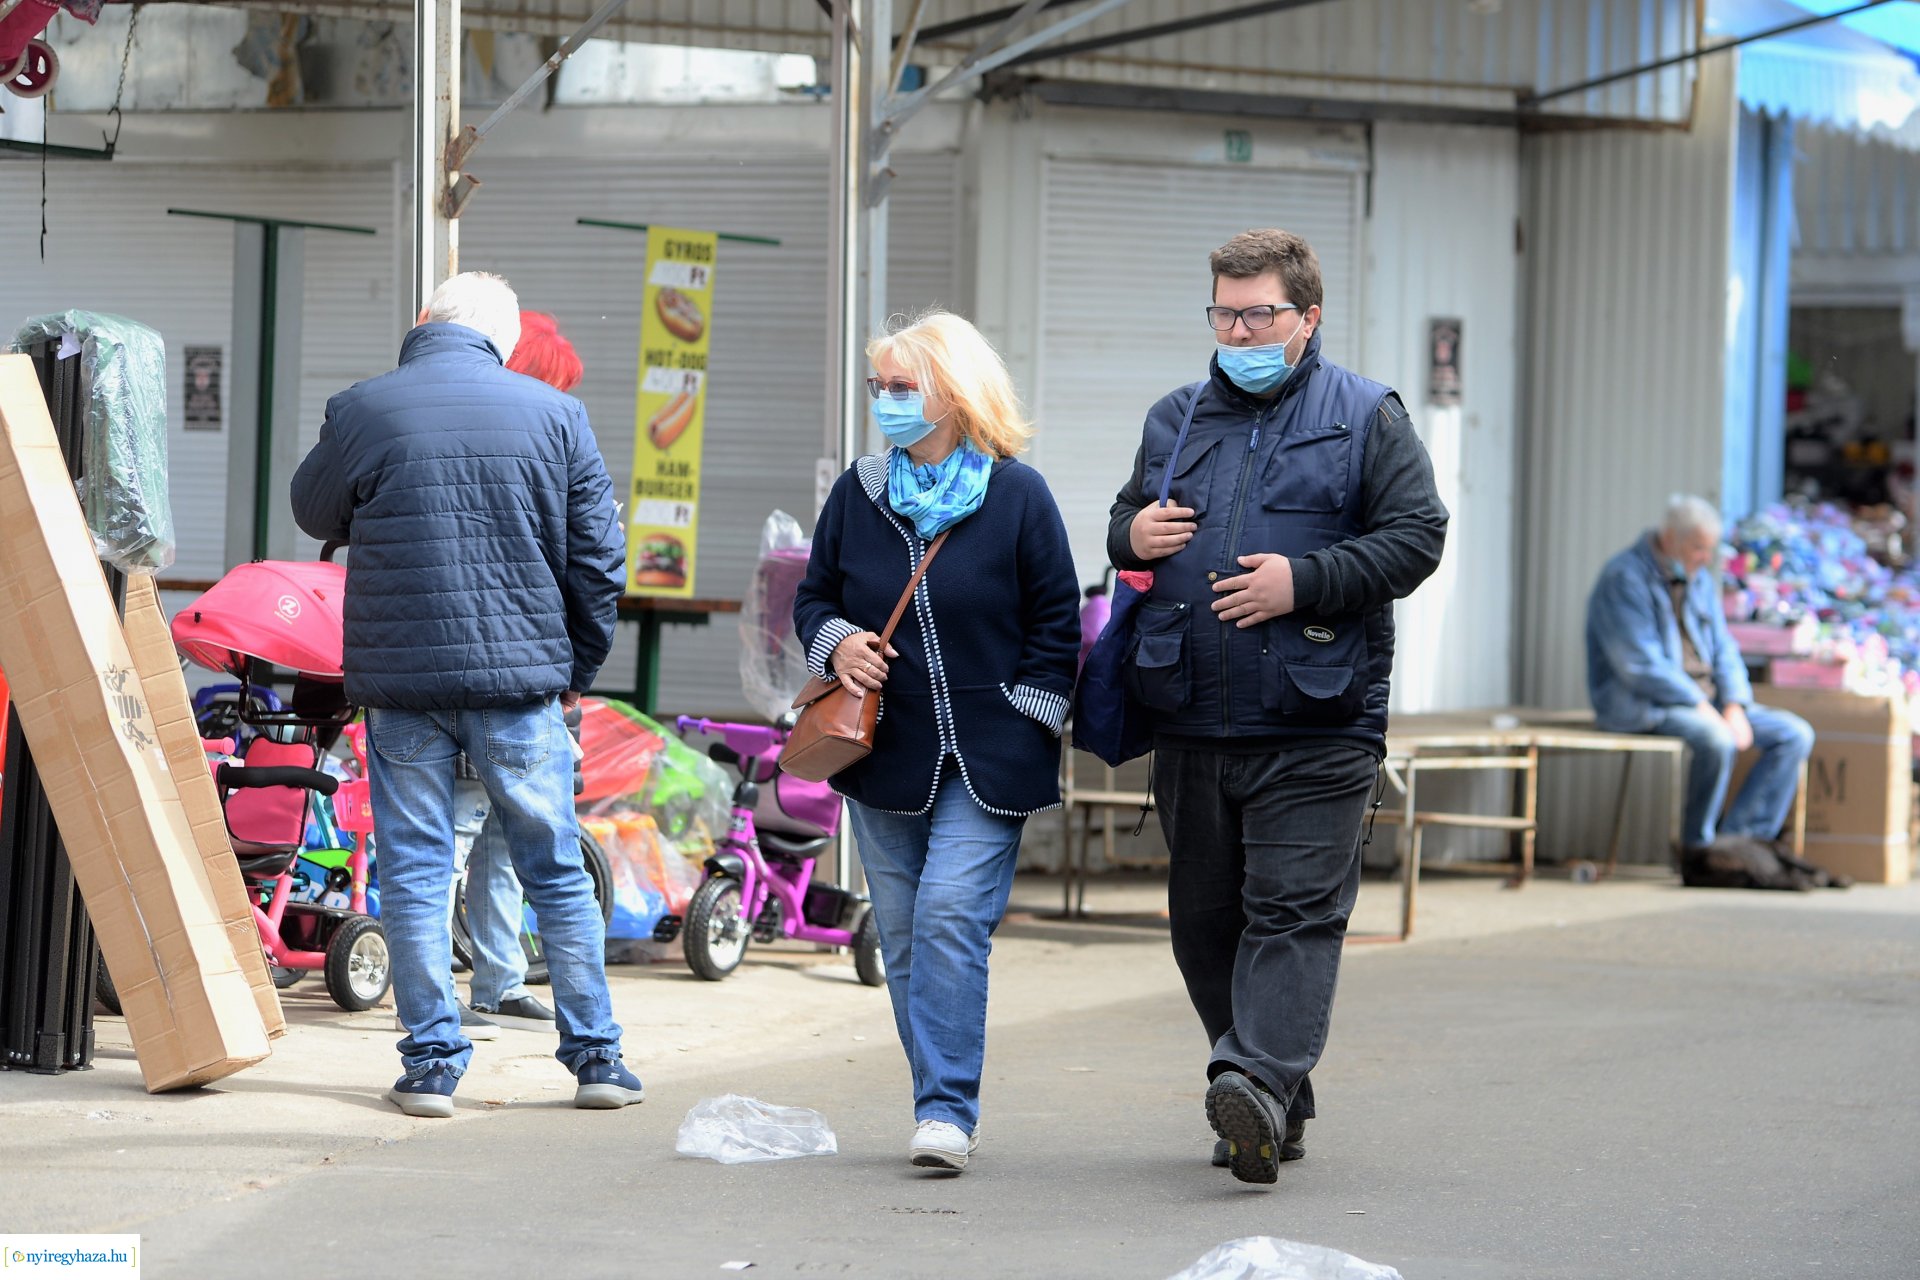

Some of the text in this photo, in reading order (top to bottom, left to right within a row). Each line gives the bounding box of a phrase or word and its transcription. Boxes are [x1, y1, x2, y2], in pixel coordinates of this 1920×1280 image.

[664, 239, 712, 262] GYROS
[646, 349, 707, 370] HOT-DOG
[635, 478, 695, 498] BURGER
